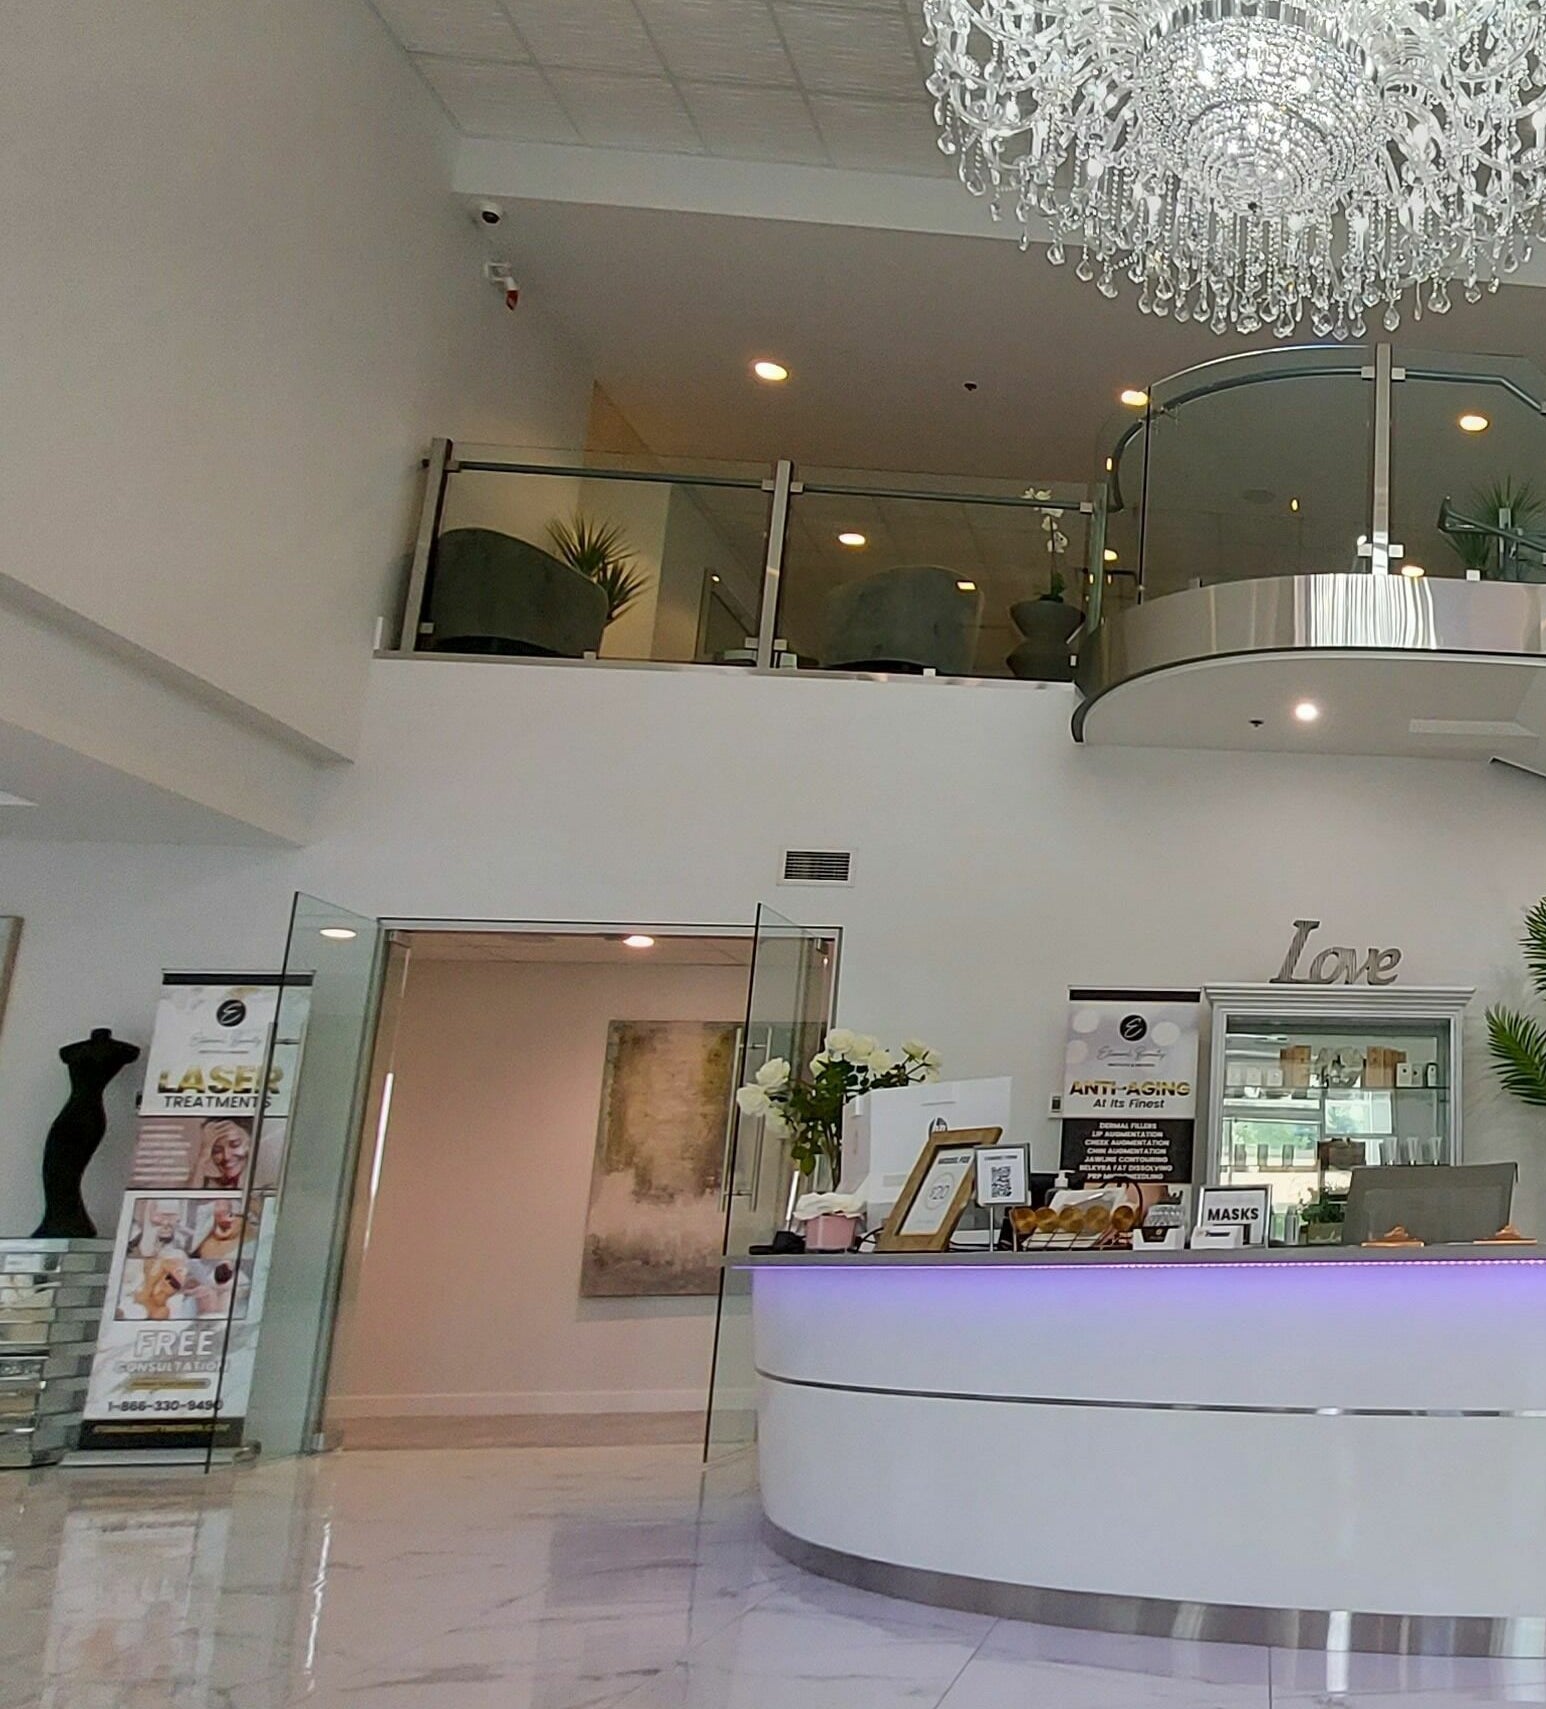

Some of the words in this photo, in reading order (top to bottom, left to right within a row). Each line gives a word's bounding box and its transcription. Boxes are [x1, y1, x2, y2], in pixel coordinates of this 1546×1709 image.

[1269, 919, 1402, 986] Love
[158, 1065, 284, 1094] LASER
[1070, 1081, 1191, 1096] ANTI-AGING
[164, 1095, 272, 1109] TREATMENTS
[1093, 1099, 1106, 1108] At
[1110, 1099, 1125, 1108] Its
[1128, 1098, 1165, 1109] Finest
[1099, 1122, 1129, 1130] DERMAL
[1130, 1122, 1157, 1130] FILLERS
[1086, 1147, 1106, 1155] CHIN
[1107, 1147, 1167, 1155] AUGMENTATION
[1207, 1207, 1259, 1221] MASKS
[133, 1329, 216, 1358] FREE
